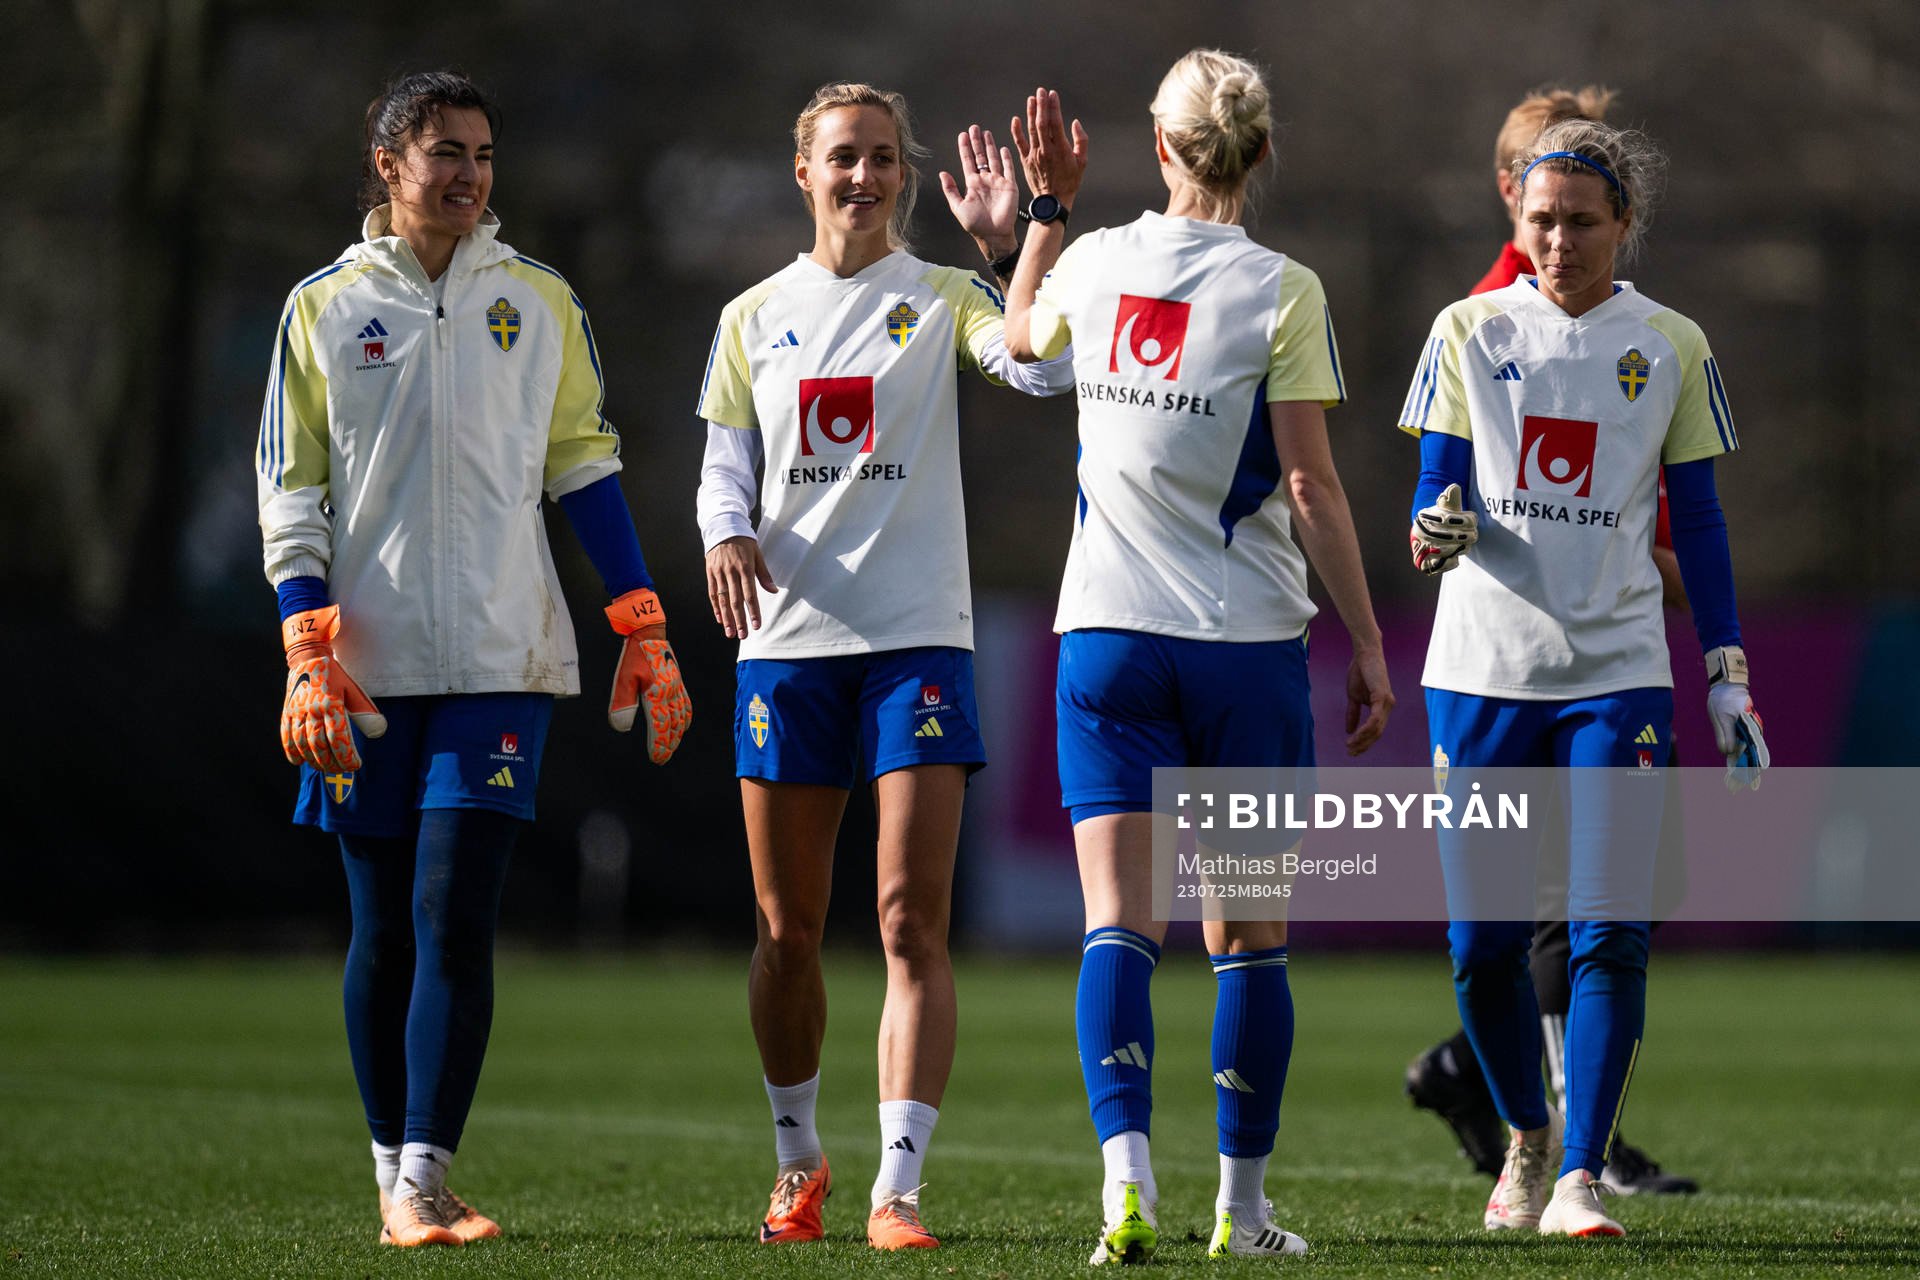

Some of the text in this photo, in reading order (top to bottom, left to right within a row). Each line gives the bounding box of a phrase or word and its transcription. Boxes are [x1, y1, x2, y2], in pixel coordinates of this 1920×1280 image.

[355, 363, 381, 371] SVENSKA
[1080, 382, 1216, 417] SVENSKA SPEL
[859, 464, 907, 480] SPEL
[1486, 497, 1570, 523] SVENSKA
